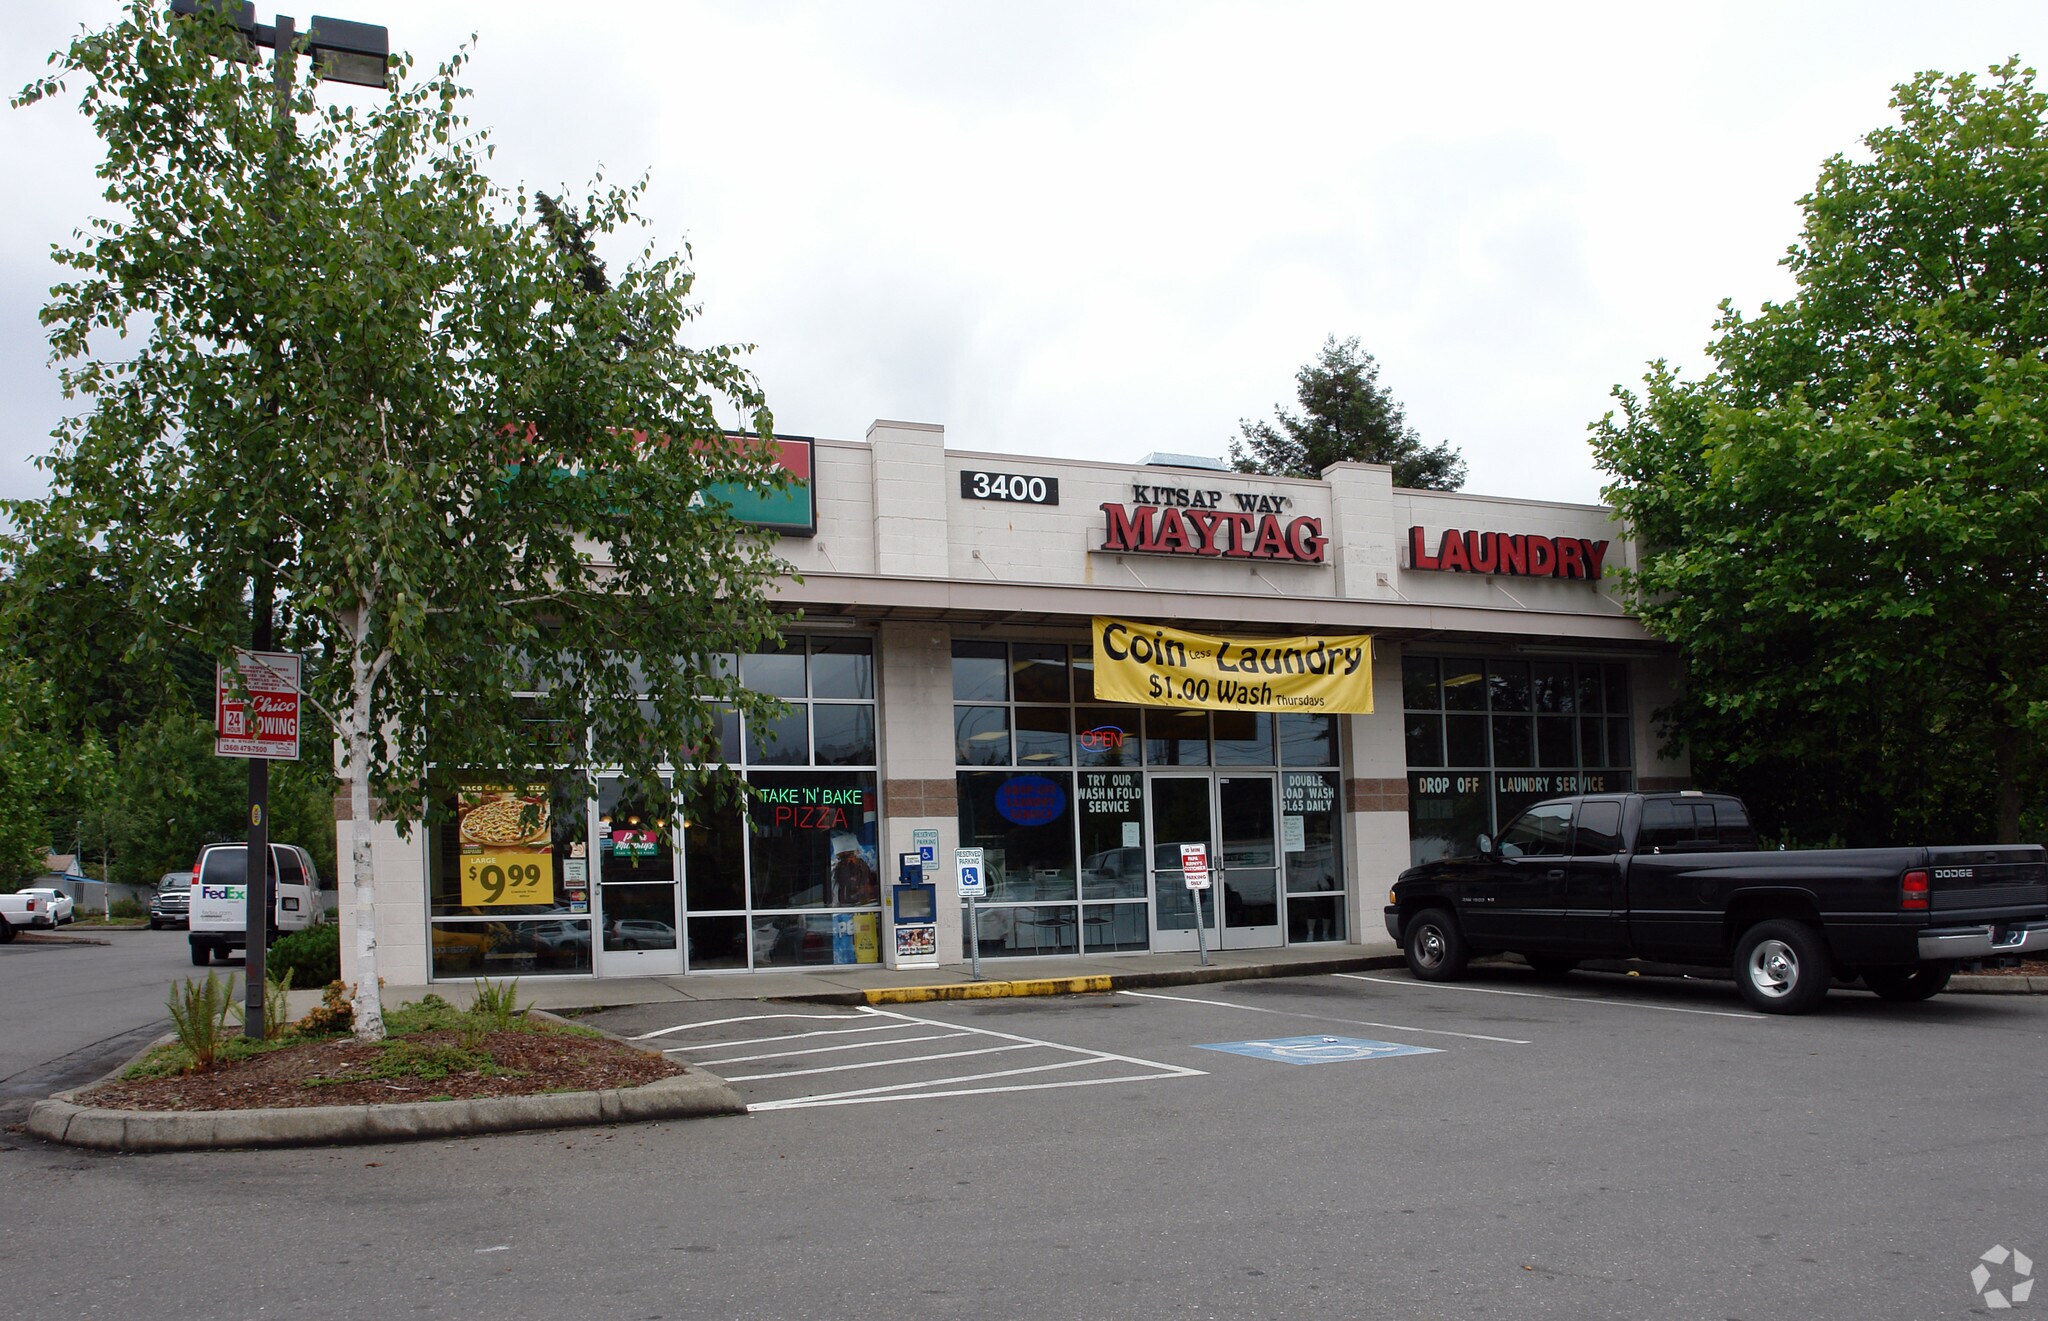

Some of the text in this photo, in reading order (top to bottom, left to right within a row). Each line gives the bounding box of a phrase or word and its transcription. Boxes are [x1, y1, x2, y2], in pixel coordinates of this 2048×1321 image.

[973, 472, 1047, 502] 3400
[1133, 484, 1287, 514] KITSAP WAY
[1100, 502, 1329, 563] MAYTAG
[1409, 526, 1609, 580] LAUNDRY
[1102, 623, 1362, 675] Coin Less Laundry
[1149, 673, 1325, 706] $1.00 Wash Thursdays
[253, 695, 296, 712] Chico
[228, 712, 241, 726] 24
[250, 716, 296, 736] OWING
[1080, 730, 1123, 747] OPEN
[223, 744, 239, 752] (360)
[240, 745, 267, 753] 479-7500
[1087, 774, 1132, 787] TRY OUR
[1289, 775, 1323, 787] DOUBLE
[1419, 777, 1479, 793] DROP OFF
[1500, 777, 1549, 793] LAUNDRY
[760, 788, 799, 803] TAKE
[823, 789, 863, 805] BAKE
[1078, 788, 1141, 800] WASH N FOLD
[1283, 788, 1335, 799] OAD WASH
[1089, 800, 1129, 813] SERVICE
[1306, 800, 1332, 811] DAILY
[775, 806, 848, 829] PIZZA
[1935, 869, 1973, 878] DODGE
[202, 886, 245, 899] FedEx
